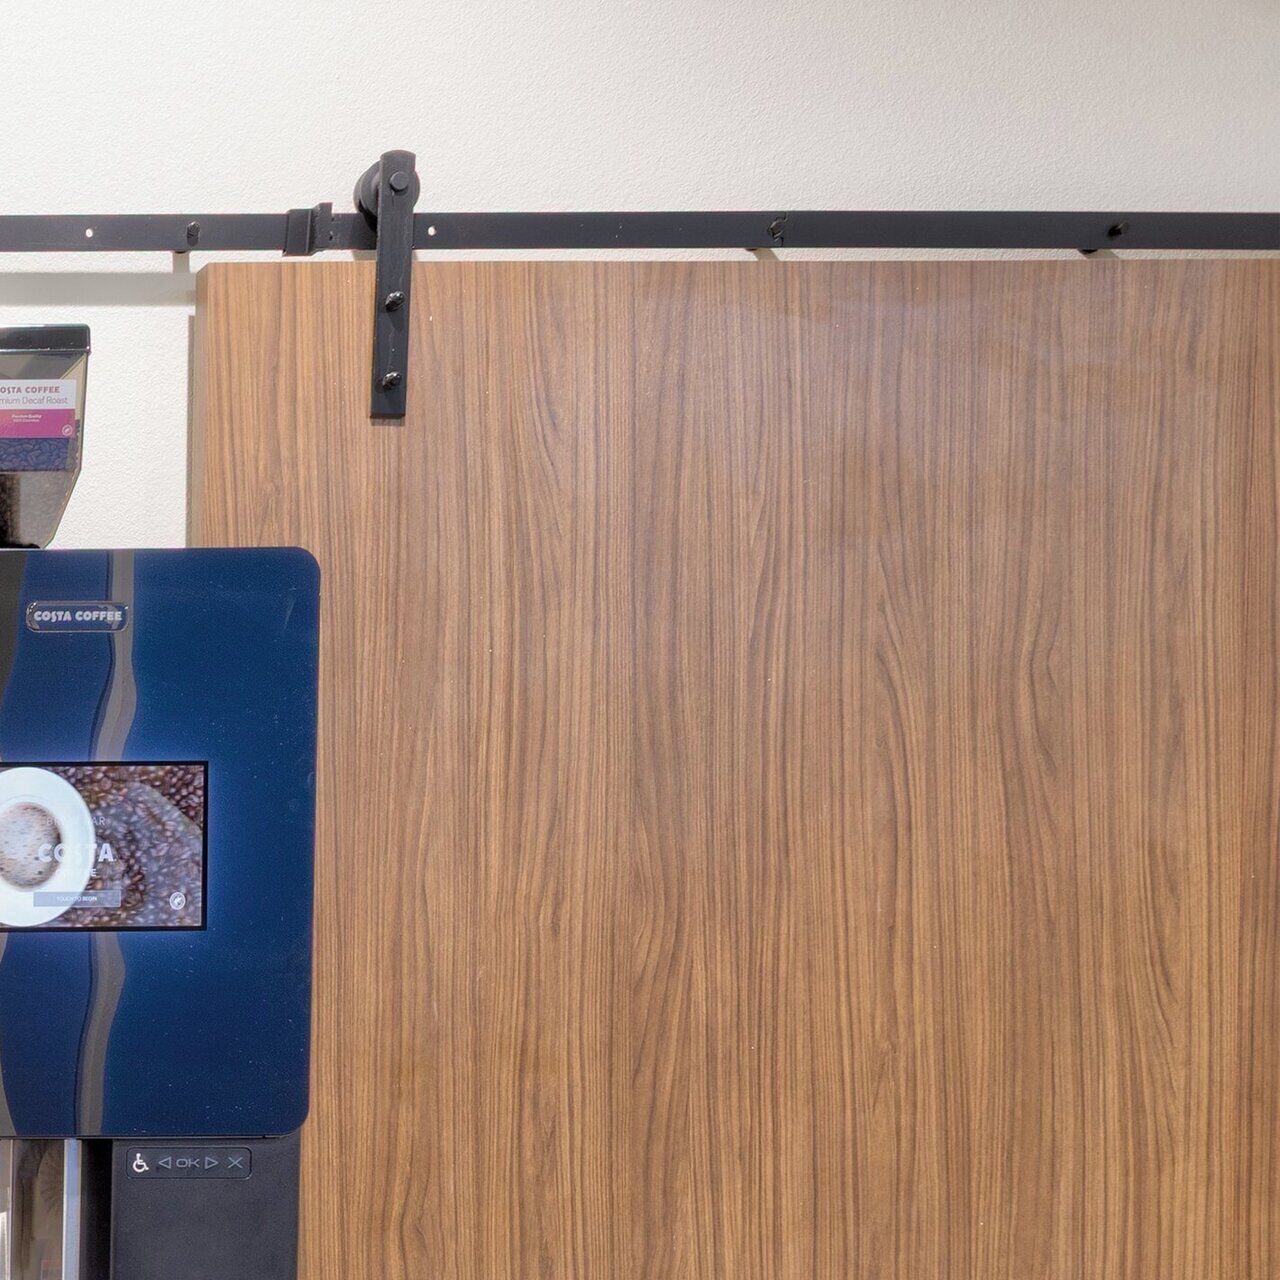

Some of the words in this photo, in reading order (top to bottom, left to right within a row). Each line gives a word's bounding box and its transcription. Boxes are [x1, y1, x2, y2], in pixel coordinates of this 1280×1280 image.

[25, 386, 60, 394] COFFEE
[22, 396, 45, 405] Decaf
[46, 396, 69, 404] Roast
[33, 611, 72, 623] COSTA
[75, 611, 122, 621] COFFEE
[176, 1158, 200, 1168] OK
